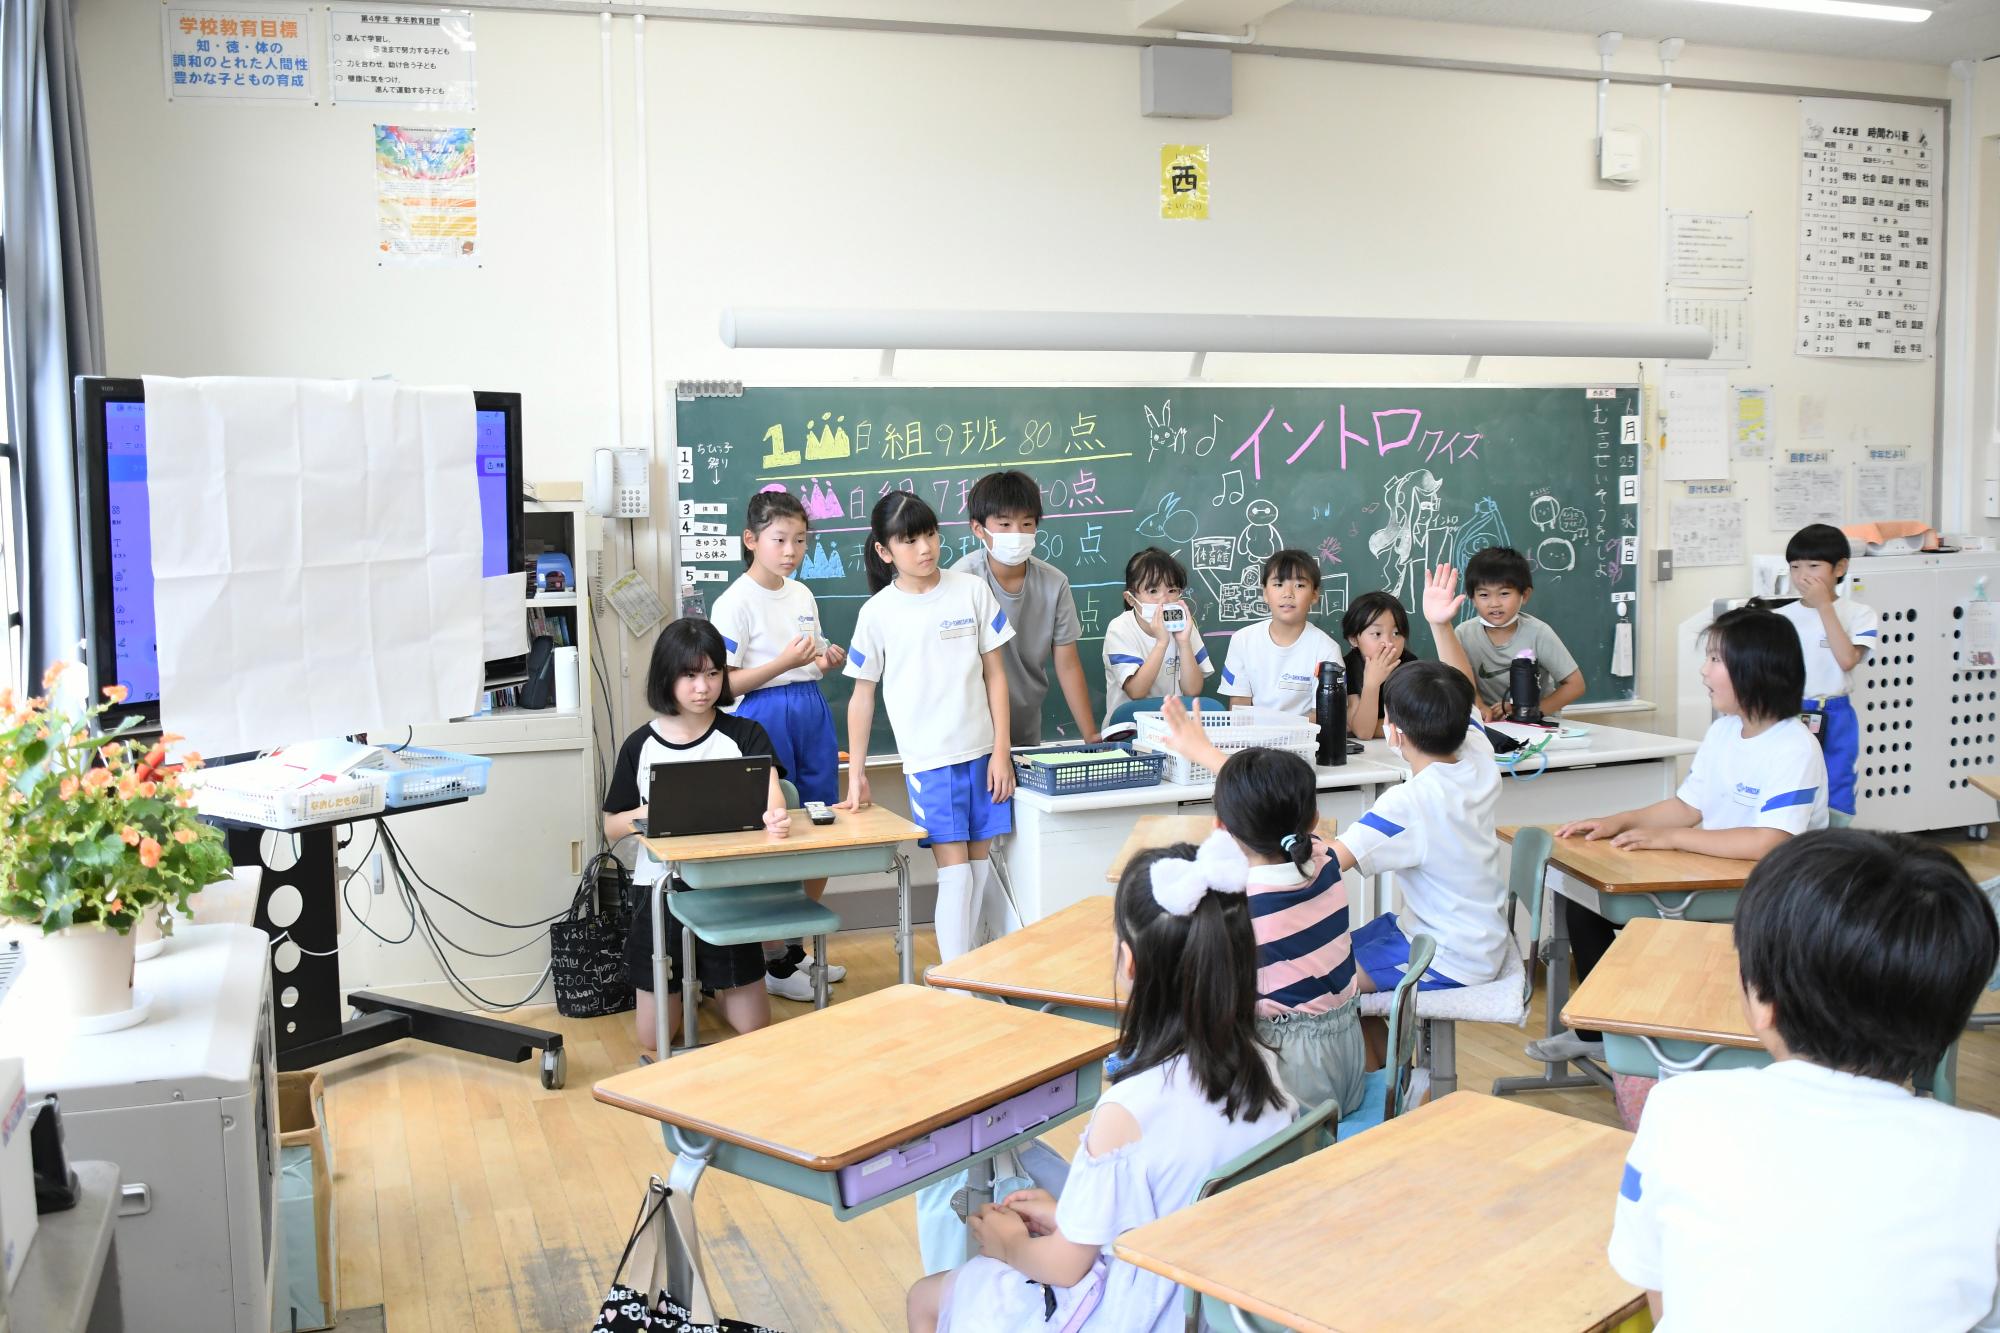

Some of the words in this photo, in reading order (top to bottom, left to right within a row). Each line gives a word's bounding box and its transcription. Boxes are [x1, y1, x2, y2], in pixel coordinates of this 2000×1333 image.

[179, 16, 298, 38] 学校教育目標
[172, 53, 309, 71] 調和のとれた人間性
[174, 71, 304, 87] 豊かな子どもの育成
[1171, 165, 1198, 194] 西
[1808, 169, 1812, 178] 1
[1842, 171, 1857, 181] 理科
[1862, 173, 1876, 183] 社会
[1915, 179, 1929, 188] 理科
[1807, 192, 1813, 201] 2
[1915, 199, 1929, 208] 理科
[1806, 229, 1812, 237] 3
[1878, 233, 1892, 243] 社会
[1804, 315, 1810, 324] 5
[1625, 421, 1636, 441] 月
[1230, 403, 1422, 480] イントロ
[1417, 429, 1484, 465] クイズ
[681, 450, 690, 463] 1
[707, 456, 728, 470] 祭り
[1619, 455, 1635, 468] 25
[682, 468, 691, 480] 2
[1624, 480, 1635, 498] 日
[683, 503, 691, 515] 3
[682, 520, 691, 533] 4
[1621, 513, 1636, 529] 水
[695, 538, 727, 547] きゅう食
[1624, 537, 1635, 562] 曜日
[695, 551, 727, 560] ひる休み
[685, 570, 694, 581] 5
[1080, 592, 1100, 633] 点
